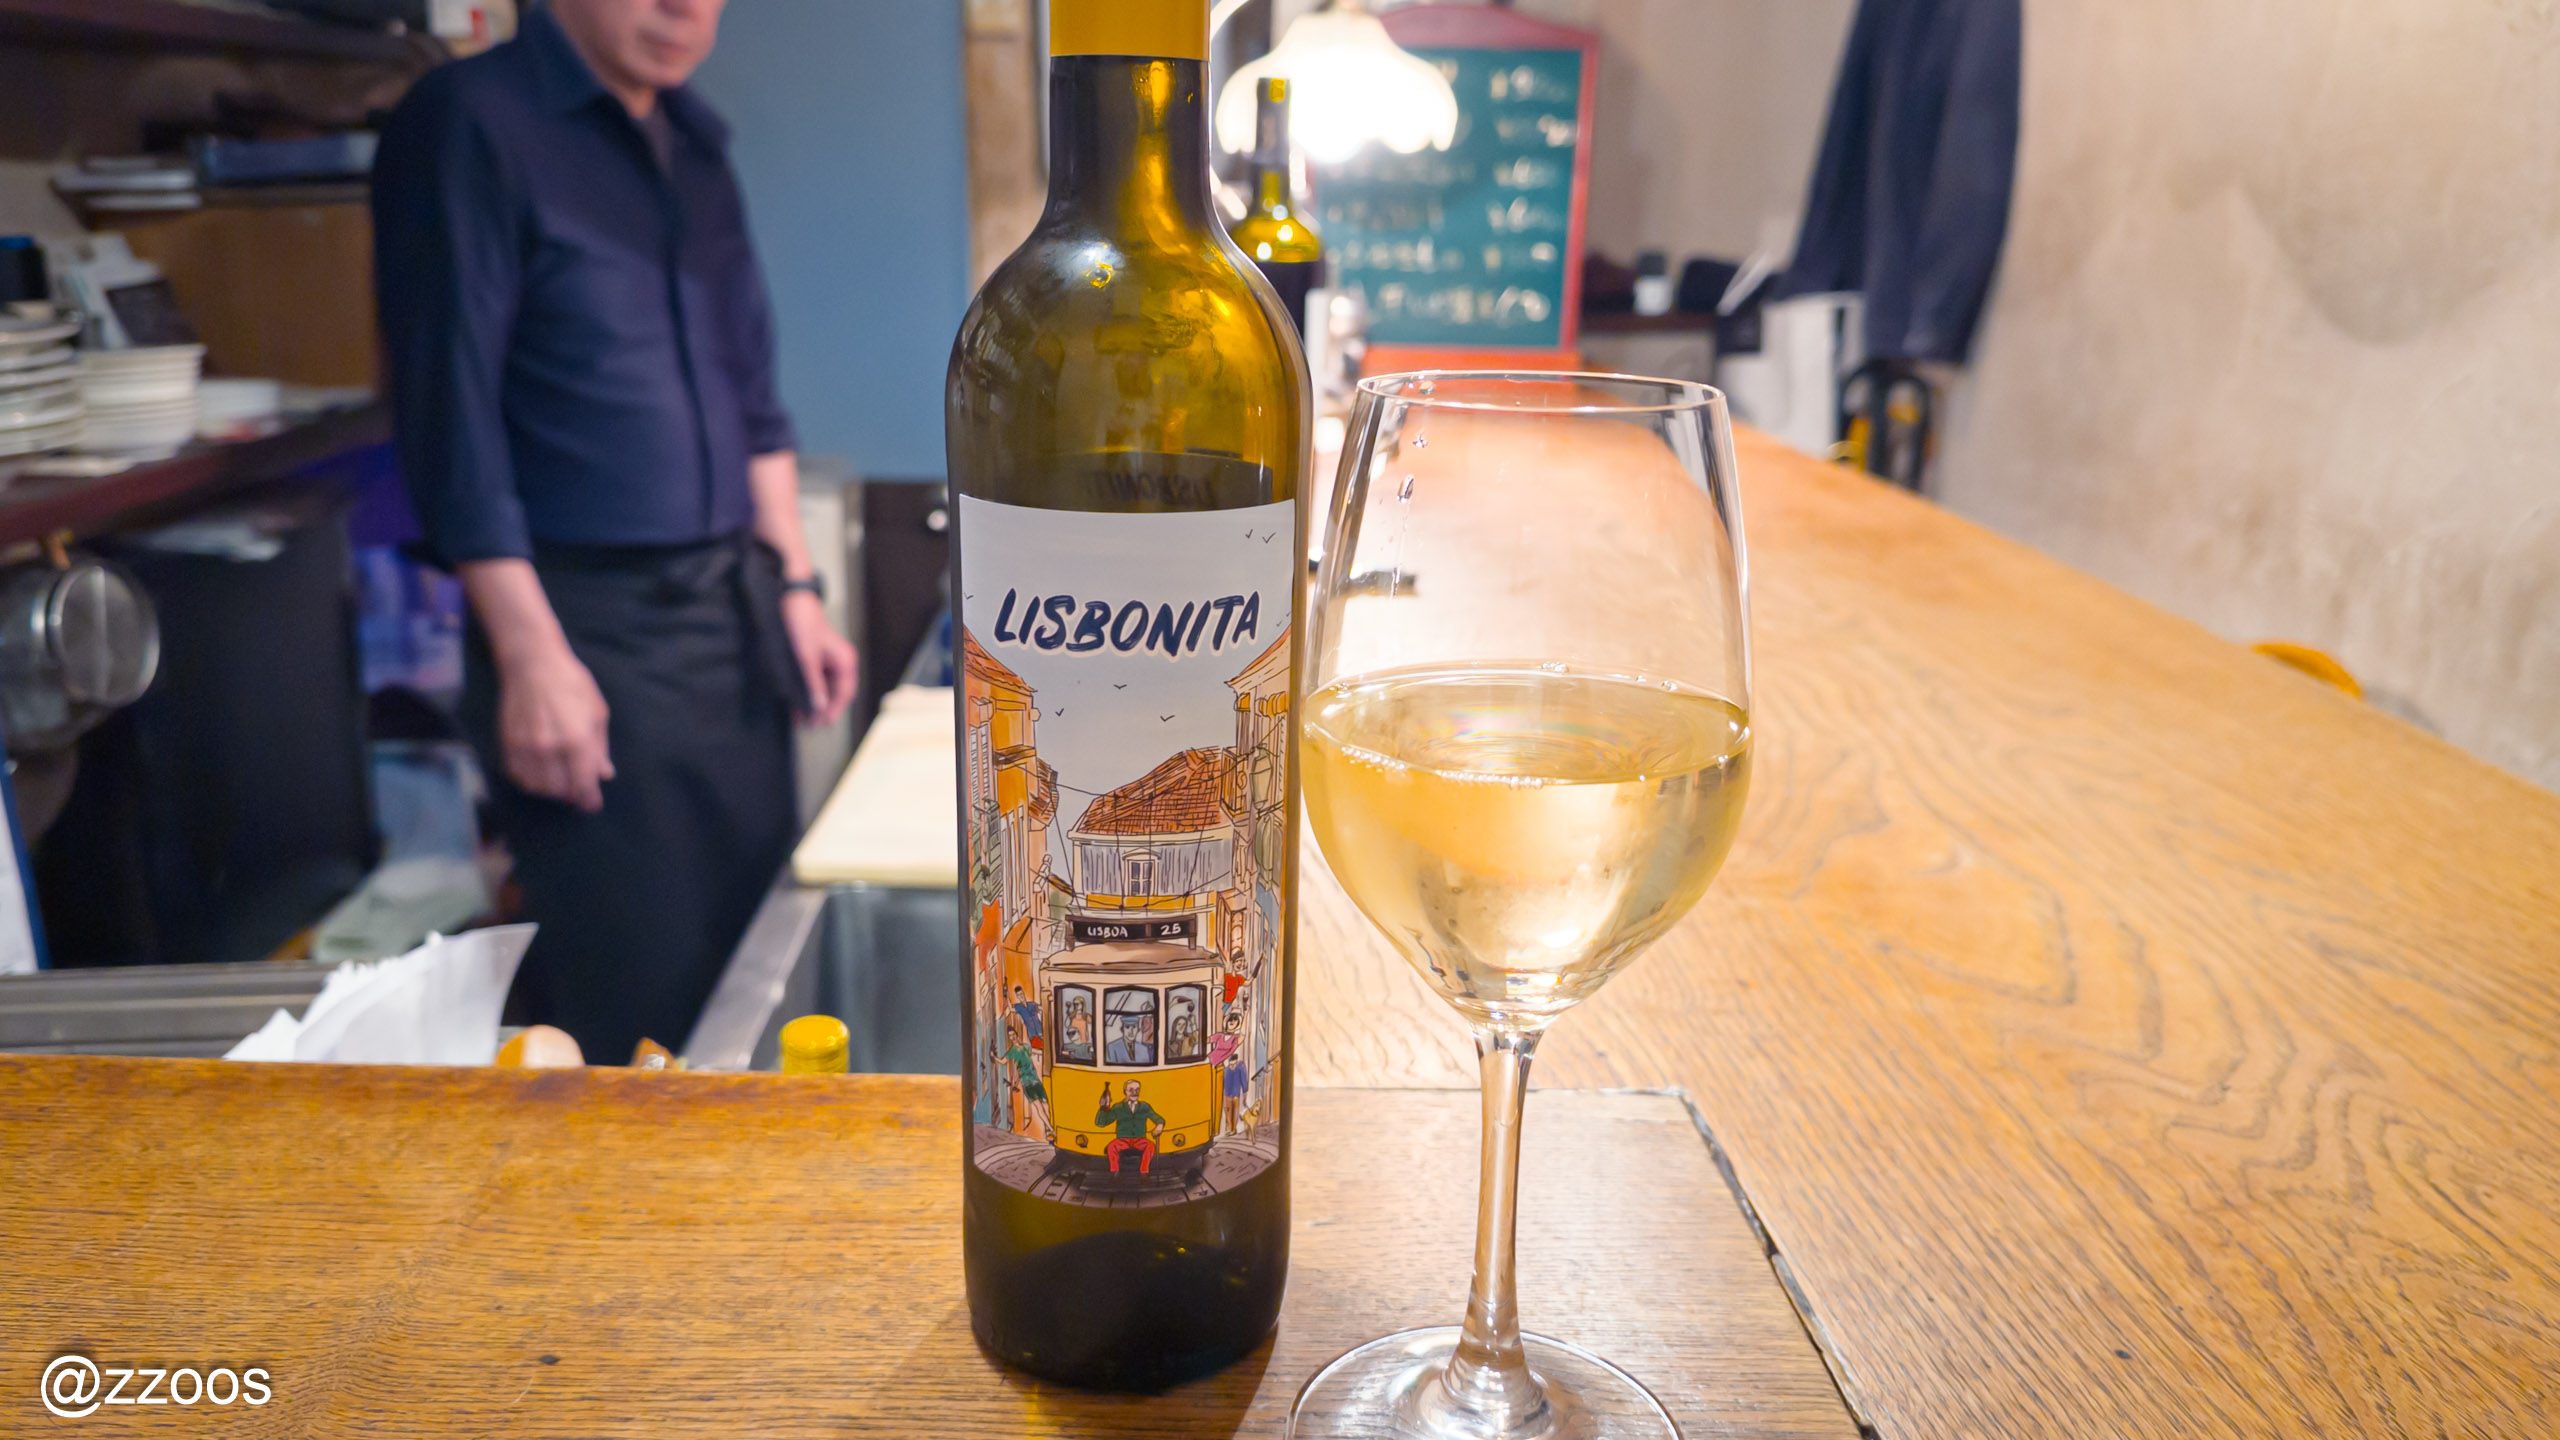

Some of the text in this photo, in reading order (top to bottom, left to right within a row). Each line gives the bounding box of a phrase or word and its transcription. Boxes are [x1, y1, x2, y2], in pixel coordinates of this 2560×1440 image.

[993, 587, 1260, 657] LISBONITA
[1087, 923, 1181, 938] LISBOA 25
